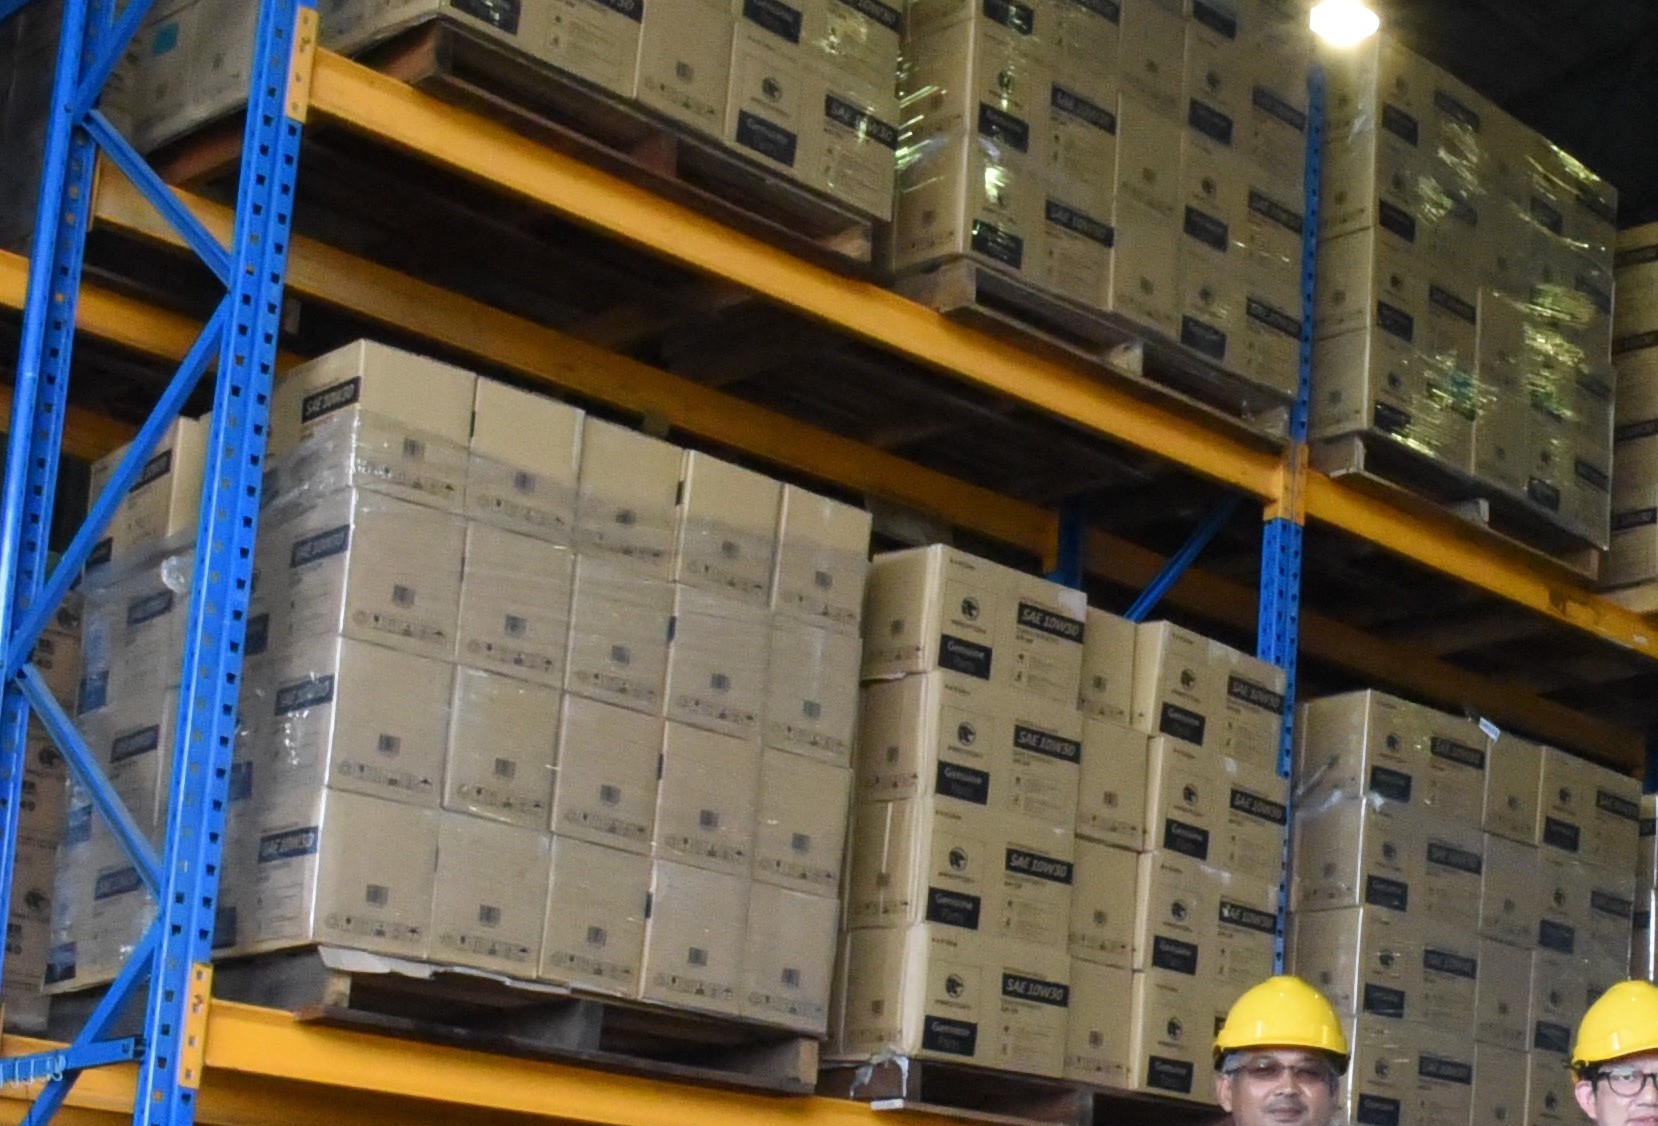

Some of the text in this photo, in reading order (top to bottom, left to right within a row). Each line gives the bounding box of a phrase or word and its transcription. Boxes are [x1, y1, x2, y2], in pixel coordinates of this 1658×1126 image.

[1021, 608, 1080, 636] SAE 10W30
[1018, 731, 1076, 757] SAE 10W30
[1010, 854, 1031, 868] SAE
[1006, 978, 1064, 1001] SAE 10W30
